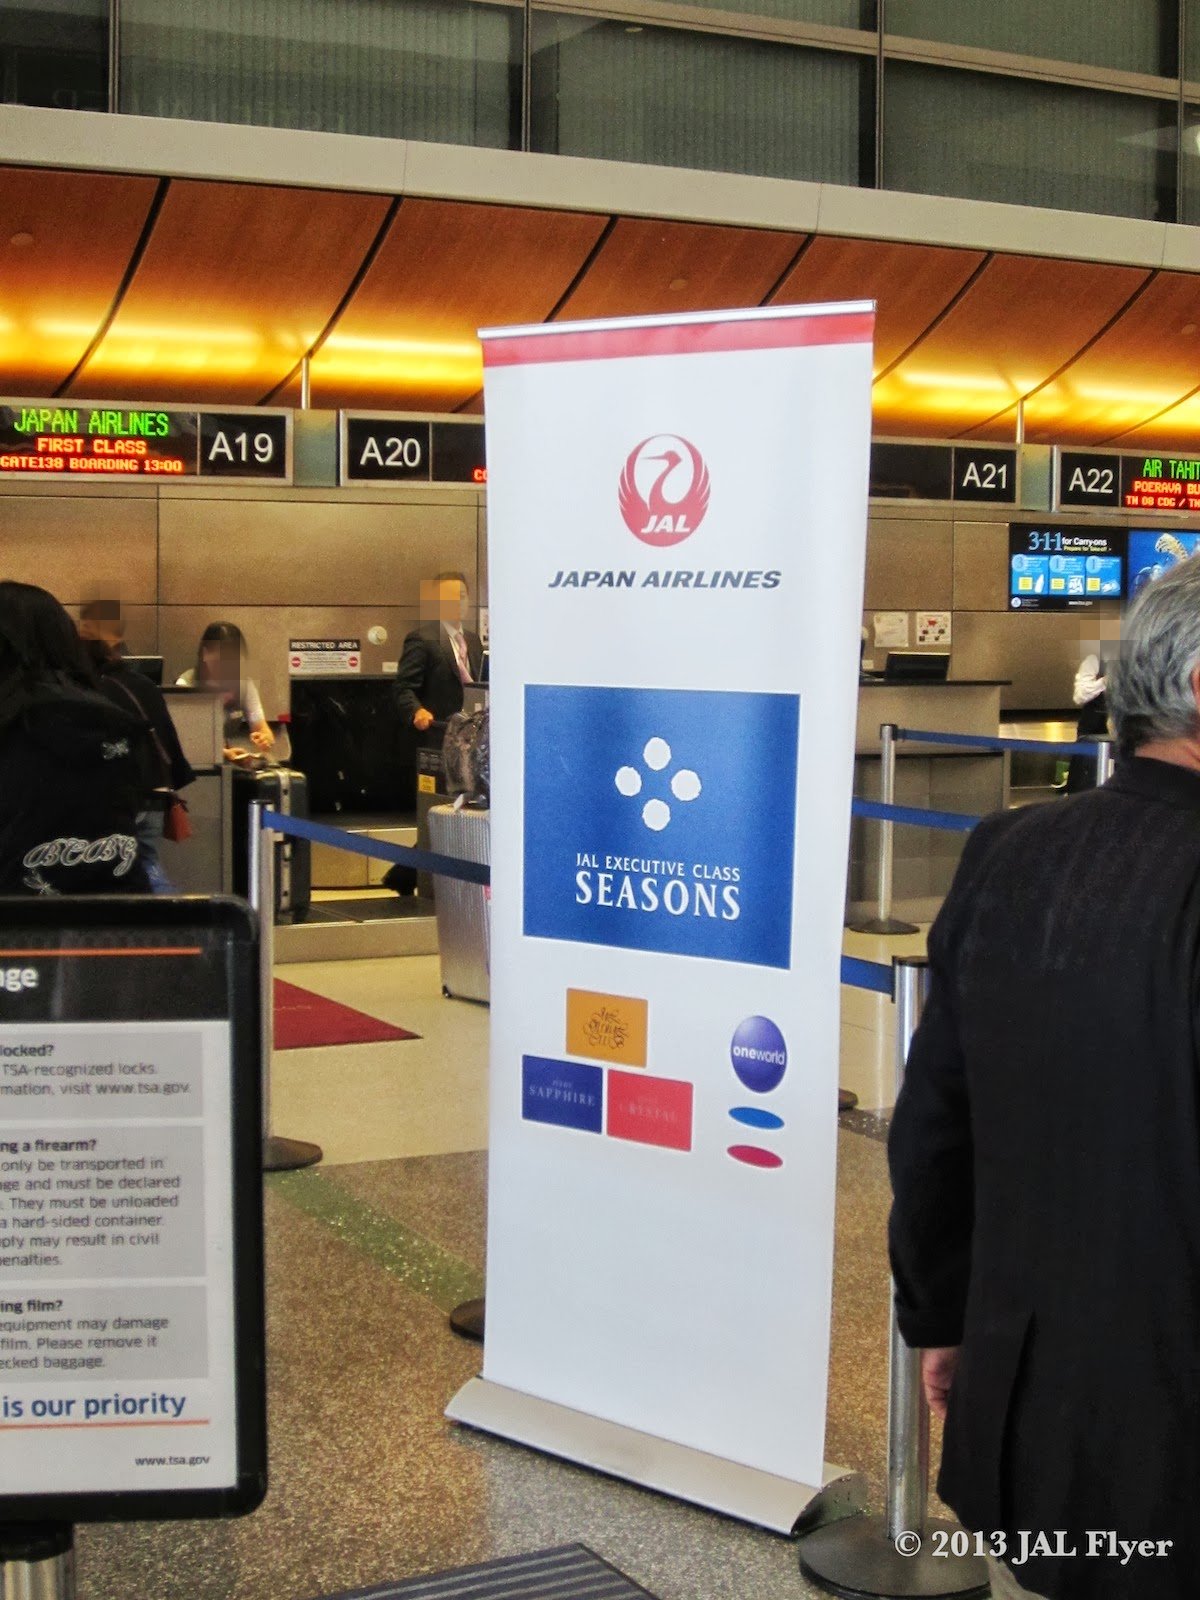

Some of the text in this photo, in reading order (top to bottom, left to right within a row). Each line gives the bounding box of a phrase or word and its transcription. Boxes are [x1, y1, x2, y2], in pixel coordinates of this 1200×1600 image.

[14, 408, 169, 436] JAPAN AIRLINES
[37, 437, 147, 455] FIRST CLASS
[209, 432, 273, 463] A19
[360, 437, 421, 467] A20
[1, 456, 183, 472] GATE138 BOARDING 13:00
[1143, 459, 1163, 478] AIR
[963, 461, 1008, 489] A21
[1069, 467, 1114, 494] A22
[1157, 497, 1176, 507] CDG
[641, 514, 690, 533] JAL
[1062, 537, 1073, 545] for
[548, 571, 782, 588] JAPAN AIRLINES
[576, 853, 741, 881] JAL EXECUTIVE CLASS
[576, 871, 741, 920] SEASONS
[733, 1046, 785, 1065] oneworld
[3, 1063, 113, 1077] TSA-recognized
[60, 1082, 91, 1094] visit
[22, 1142, 31, 1151] a
[35, 1139, 97, 1151] firearm?
[1, 1157, 164, 1173] only be transported in
[25, 1178, 51, 1190] and
[56, 1178, 90, 1189] must
[96, 1177, 113, 1189] be
[118, 1176, 181, 1188] declared
[10, 1195, 178, 1211] They must be unloaded
[12, 1216, 90, 1228] hard-sided
[30, 1237, 60, 1249] may
[66, 1233, 106, 1246] result
[112, 1234, 124, 1245] in
[129, 1233, 160, 1245] civil
[27, 1299, 63, 1311] film?
[77, 1320, 107, 1332] may
[112, 1317, 169, 1329] damage
[37, 1337, 83, 1349] Please
[88, 1338, 142, 1348] remove
[147, 1336, 157, 1347] it
[3, 1393, 186, 1419] is our priority
[135, 1455, 209, 1466] www.tsa.gov
